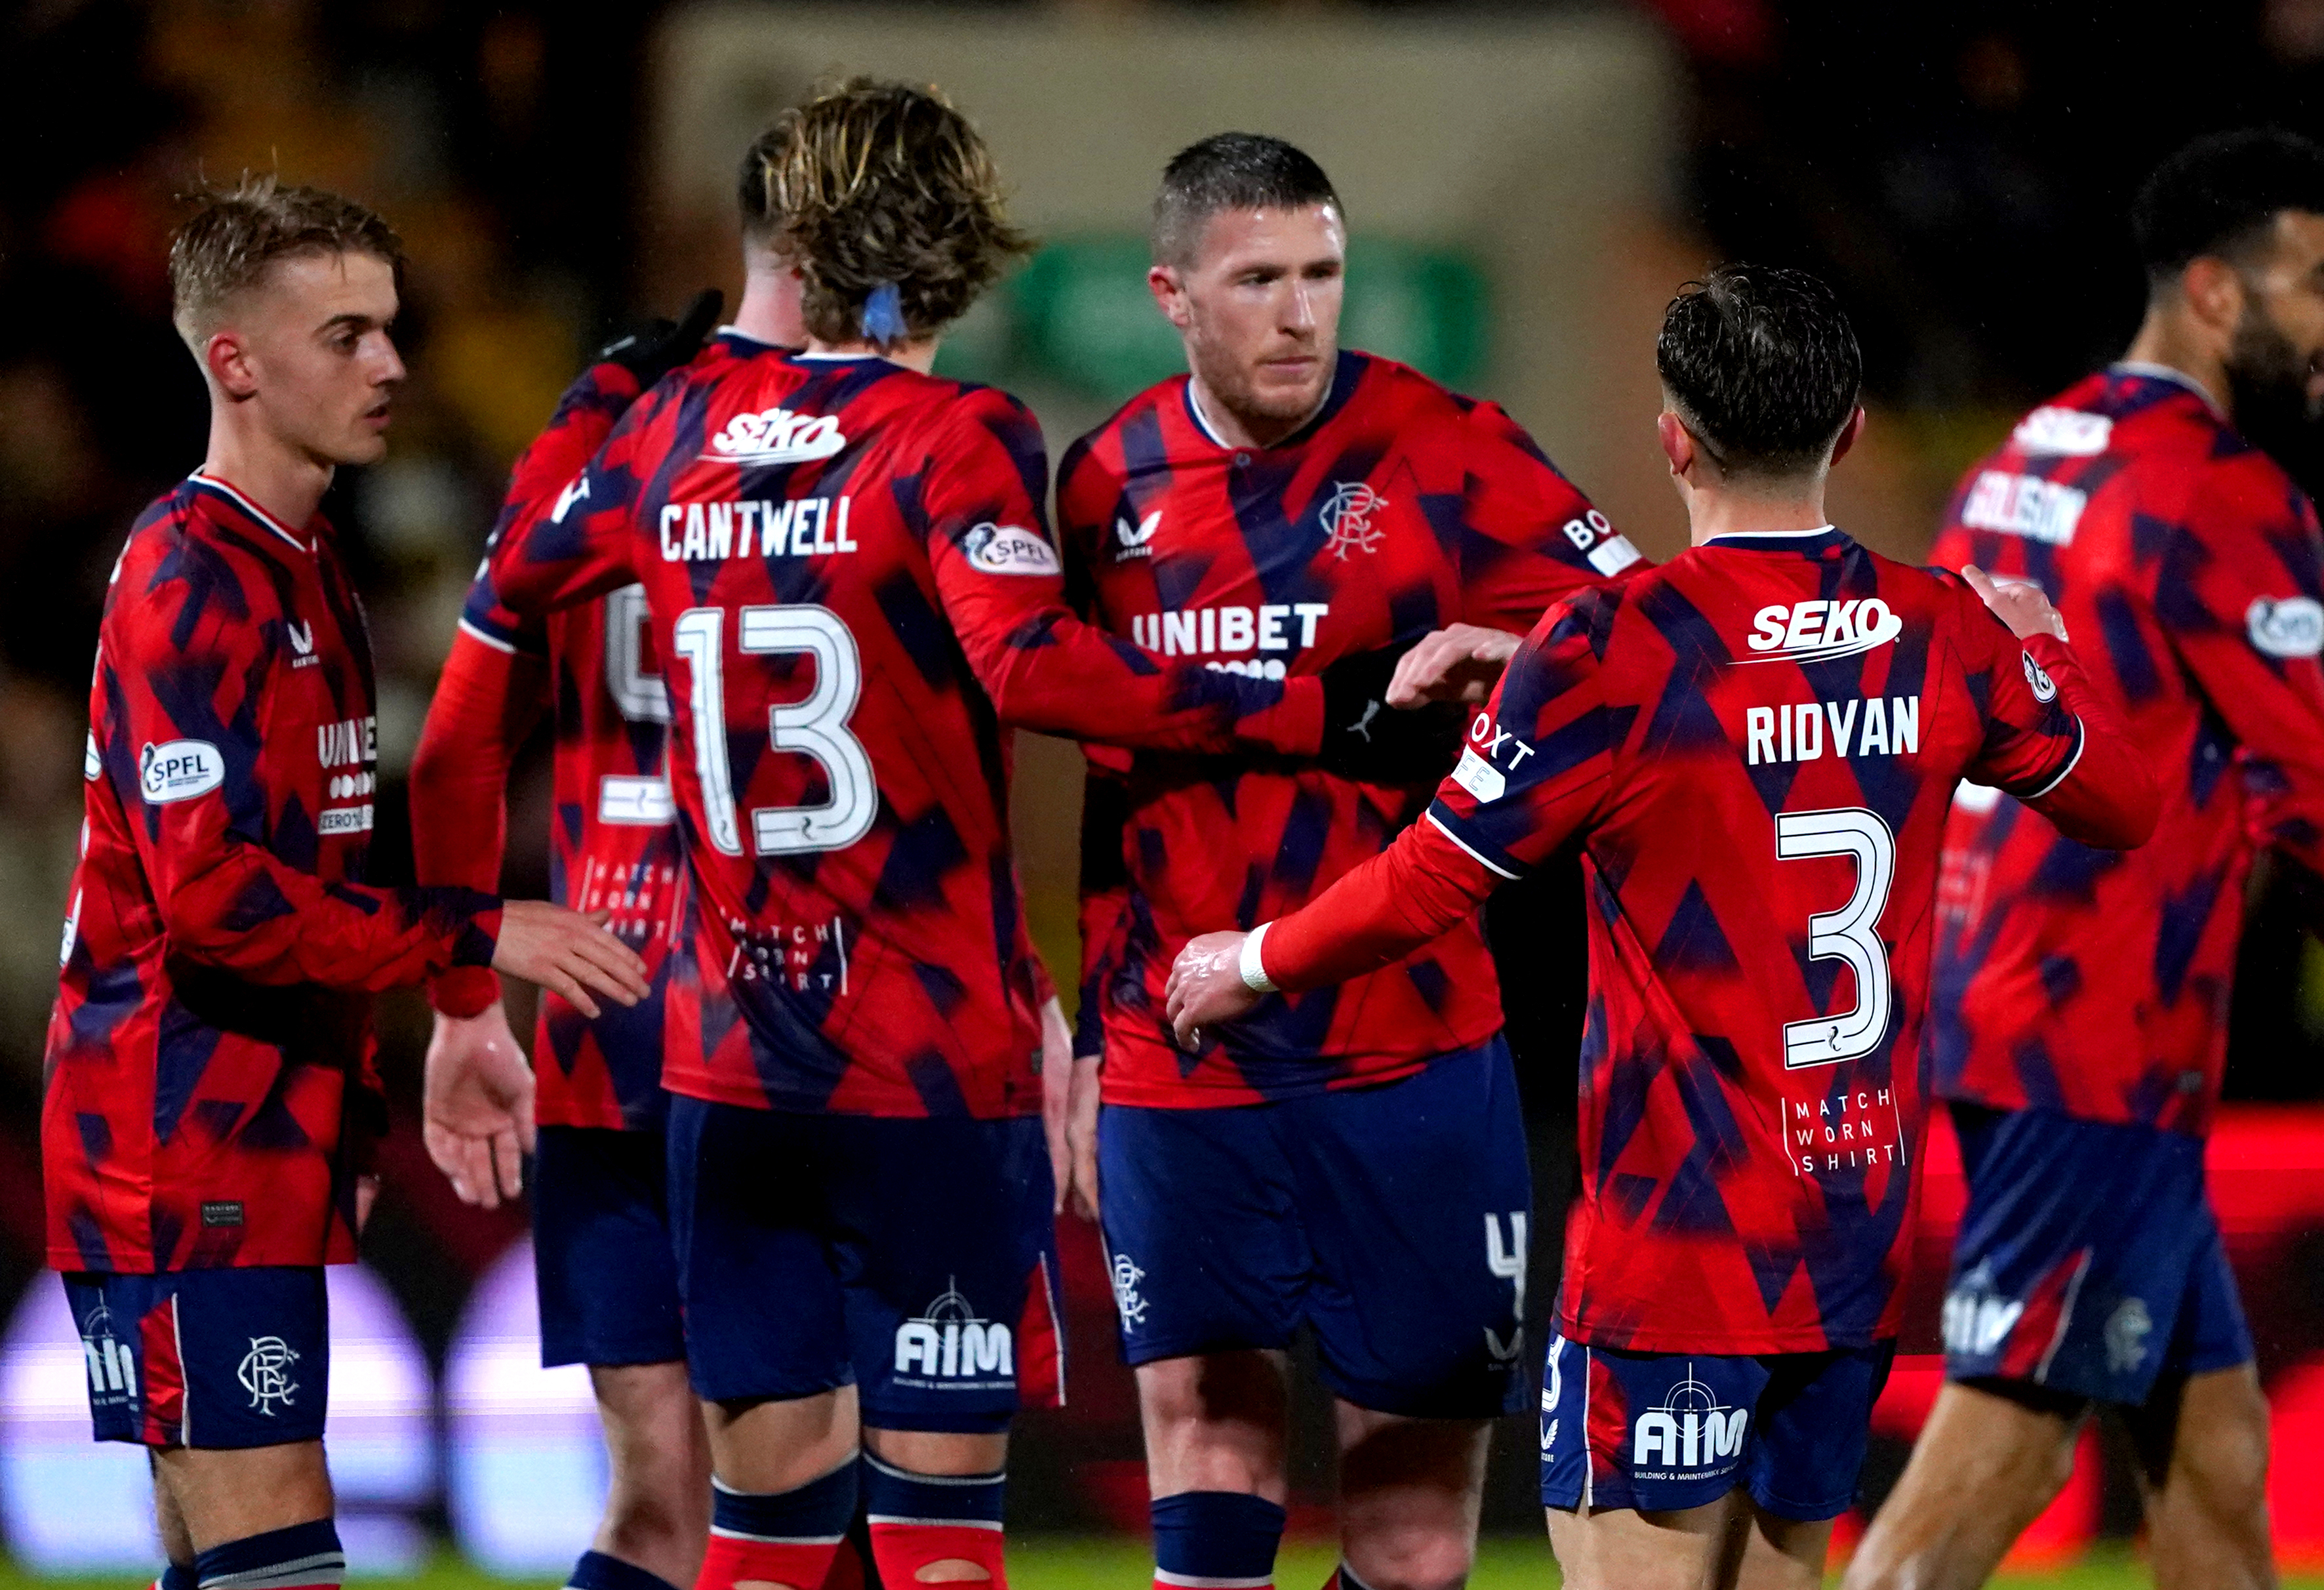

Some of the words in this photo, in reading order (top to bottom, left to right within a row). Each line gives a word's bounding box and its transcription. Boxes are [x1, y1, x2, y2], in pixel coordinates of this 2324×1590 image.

[660, 496, 857, 561] CANTWELL
[1132, 603, 1329, 656] UNIBET
[1747, 598, 1902, 651] SEKO
[674, 604, 879, 857] 13
[1747, 696, 1919, 765] RIDVAN
[154, 754, 209, 782] SPFL
[731, 917, 830, 945] MTCH
[1774, 807, 1896, 1070] 3
[1795, 1088, 1890, 1119] MATCH
[1795, 1120, 1873, 1146] WORN
[1802, 1144, 1894, 1173] SHIRT
[1484, 1211, 1527, 1322] 4
[894, 1322, 1013, 1376] AIM
[1633, 1408, 1748, 1466] AIM
[1634, 1471, 1666, 1480] BUILDING
